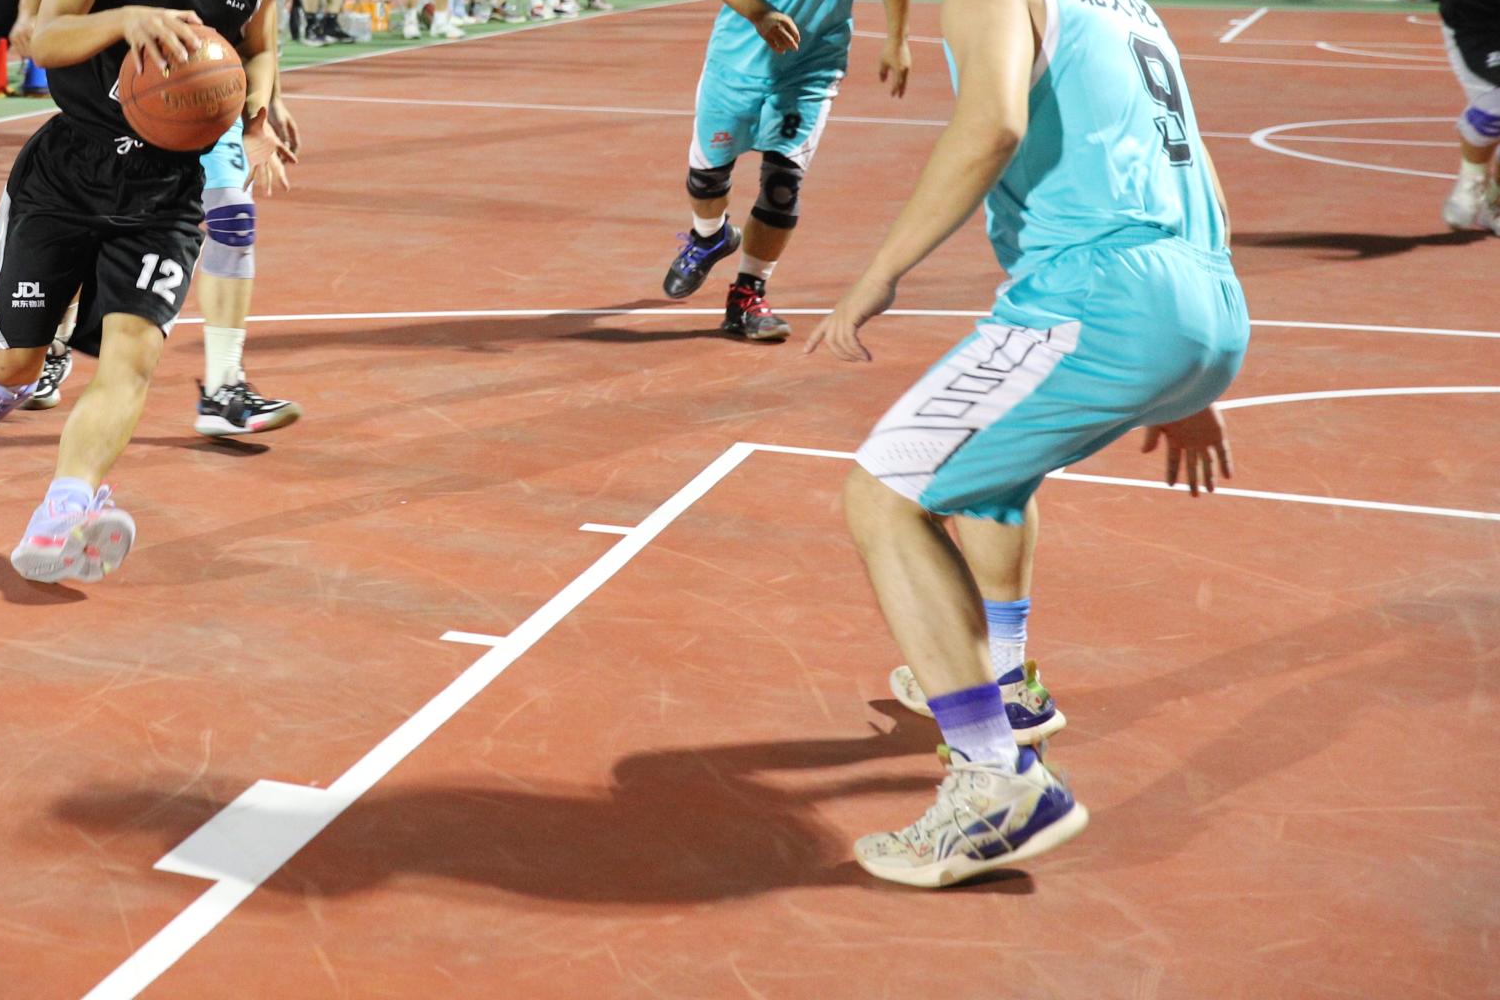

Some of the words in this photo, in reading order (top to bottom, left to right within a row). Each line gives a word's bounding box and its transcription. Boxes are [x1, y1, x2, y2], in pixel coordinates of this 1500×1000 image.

[1128, 31, 1193, 168] 9
[780, 112, 802, 139] 8
[12, 281, 46, 299] JDL
[136, 253, 184, 305] 12
